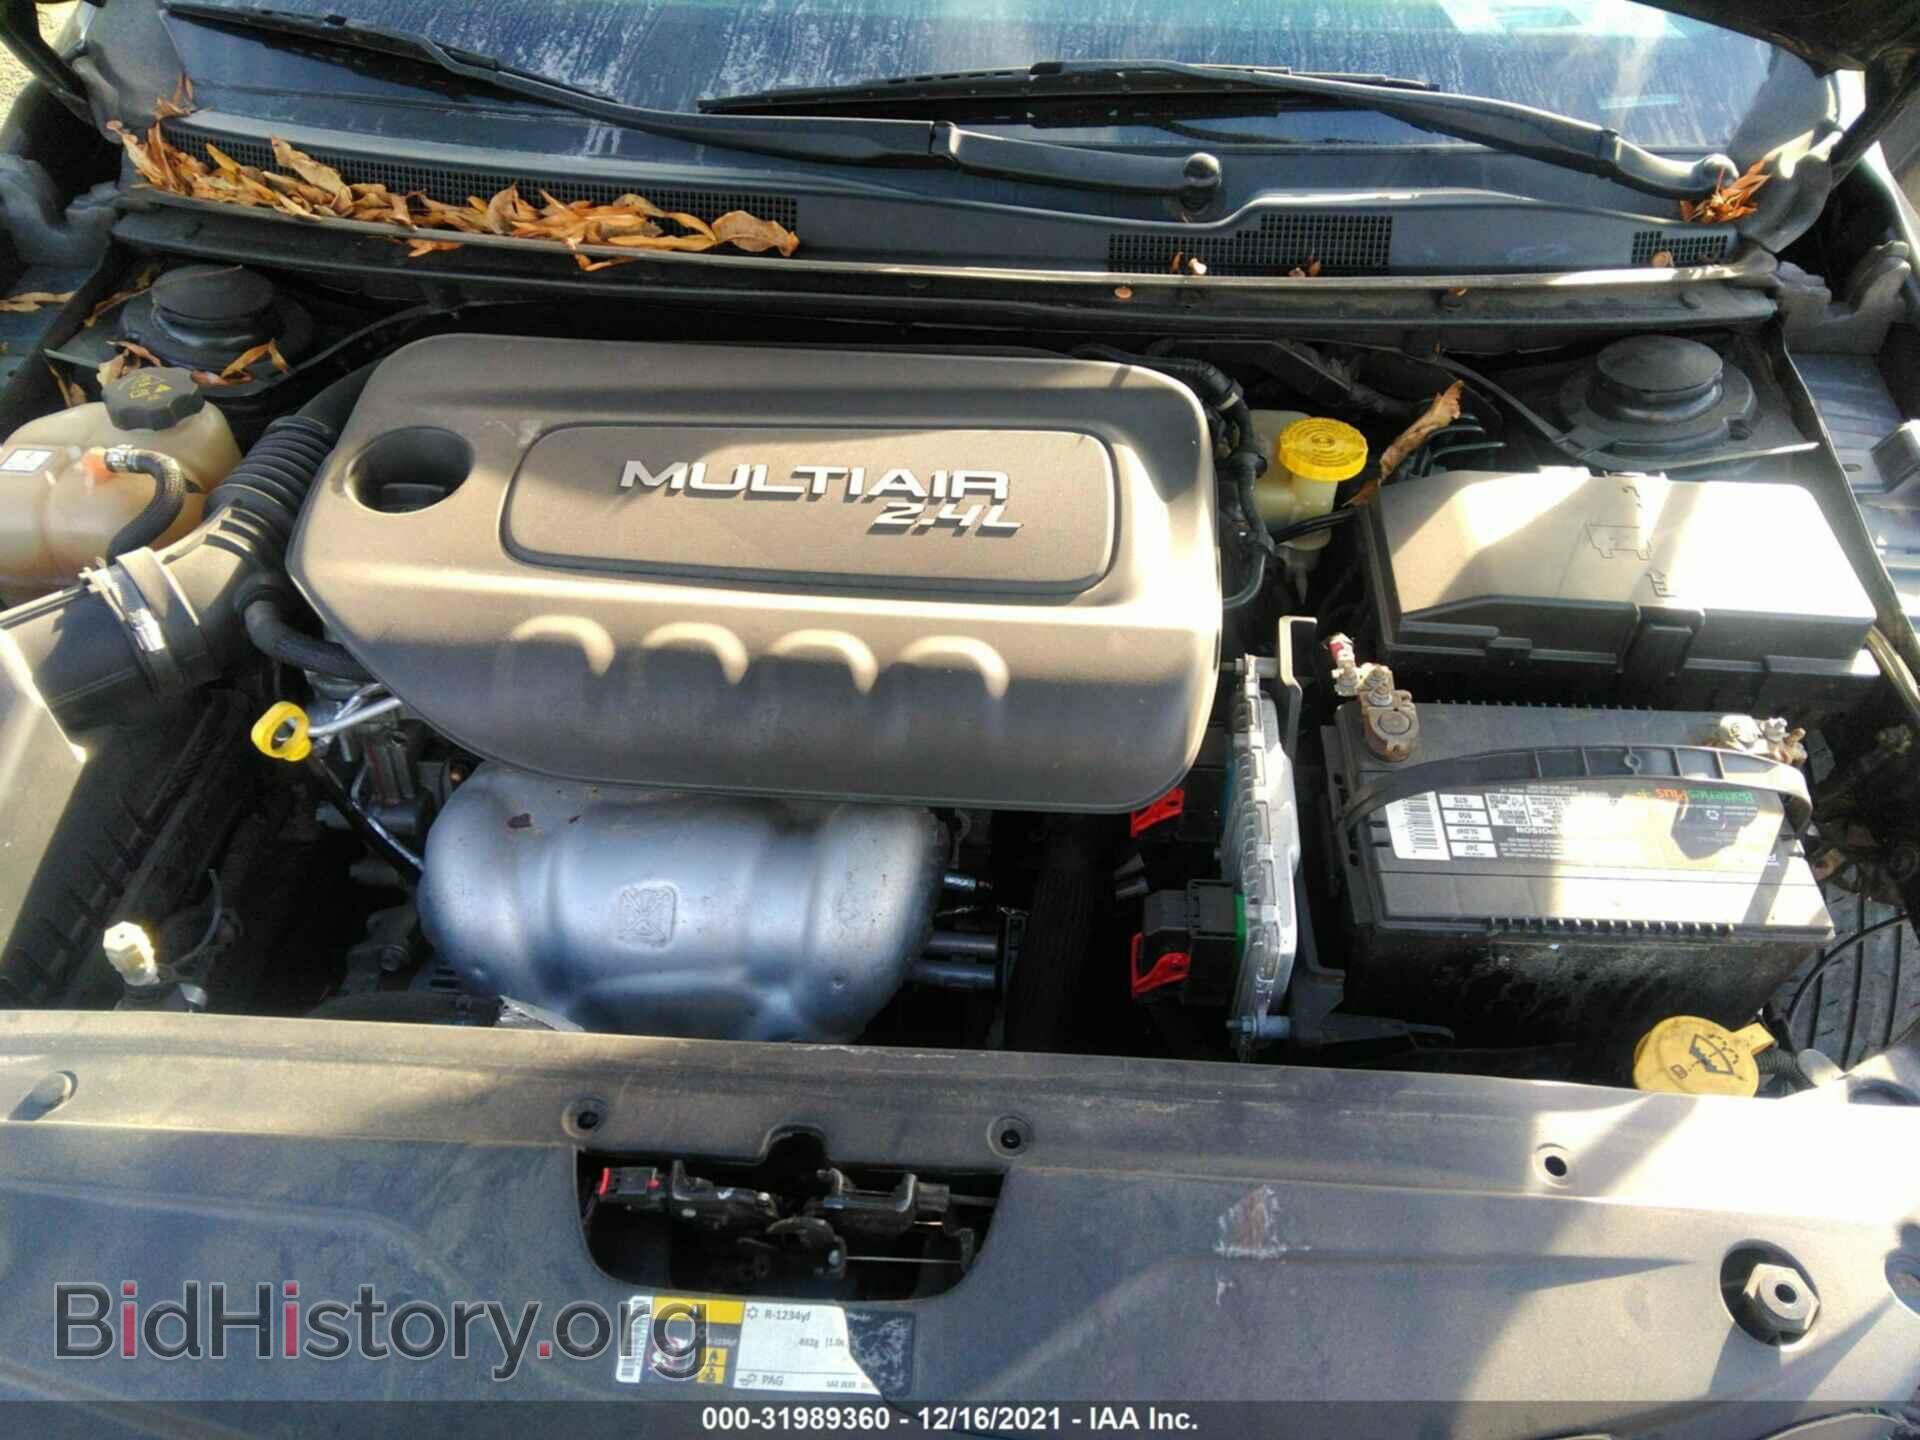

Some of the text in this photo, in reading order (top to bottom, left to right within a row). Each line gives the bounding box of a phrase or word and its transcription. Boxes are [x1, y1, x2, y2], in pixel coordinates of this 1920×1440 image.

[620, 460, 1010, 499] MULTIAIR
[871, 502, 1023, 532] 2.4L
[764, 1309, 811, 1323] R-1234yf
[761, 1375, 785, 1386] PAG
